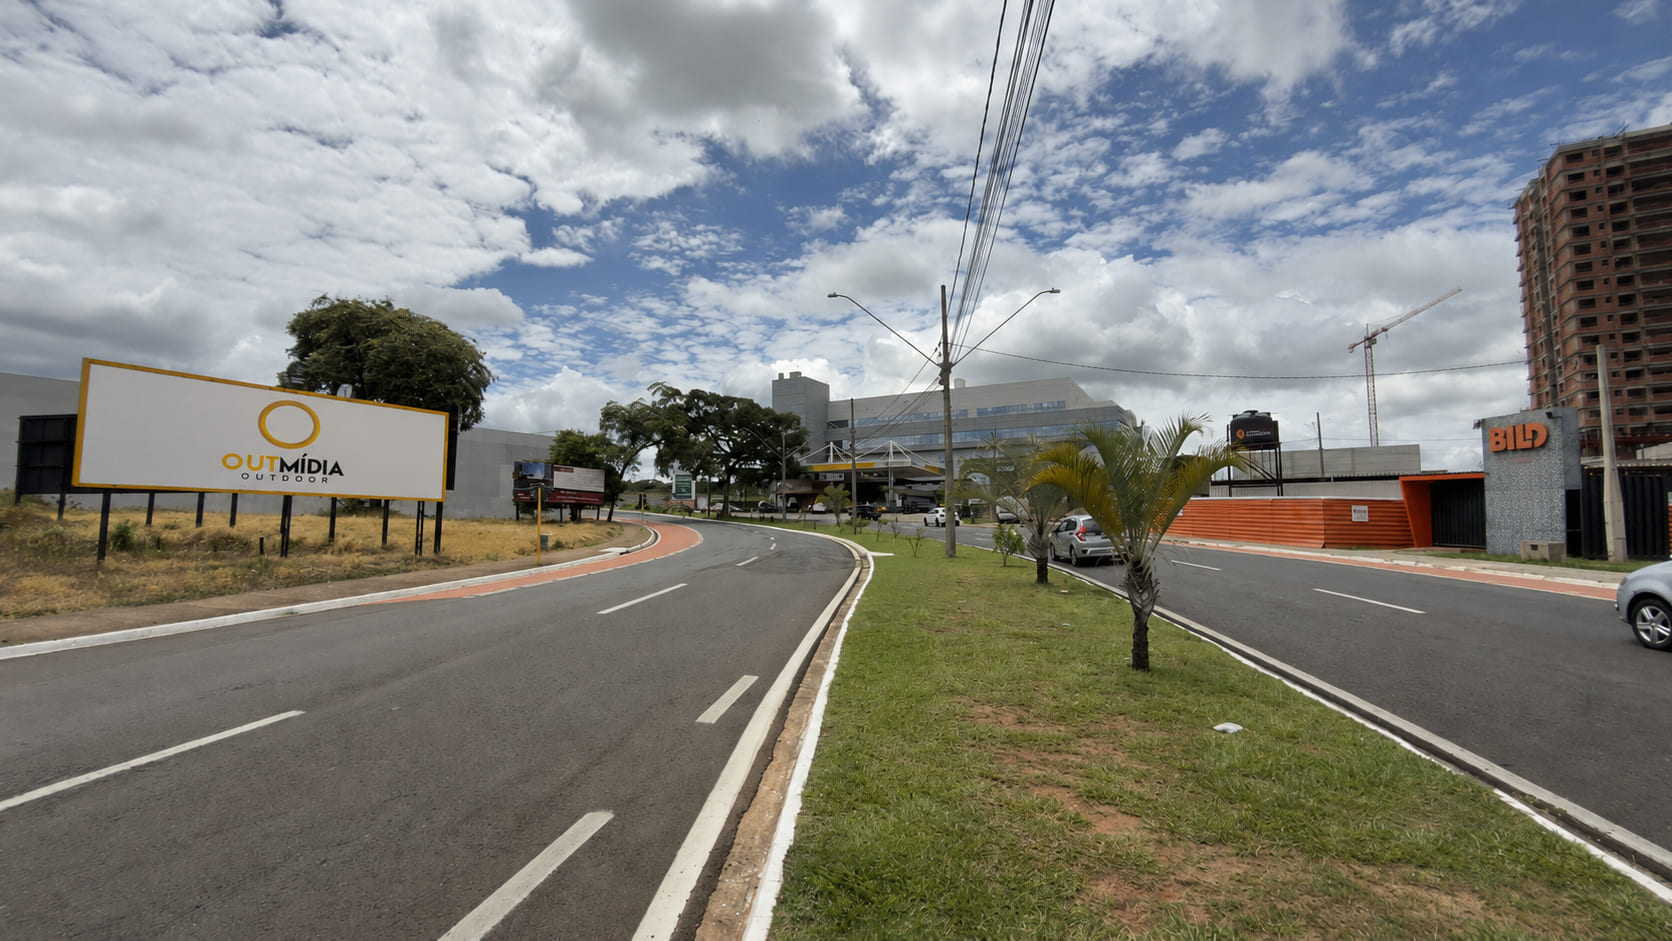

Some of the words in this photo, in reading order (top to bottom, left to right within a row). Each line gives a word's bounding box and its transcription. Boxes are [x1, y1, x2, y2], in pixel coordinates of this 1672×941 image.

[1489, 422, 1548, 452] BILD
[222, 453, 344, 476] OUTMÍDIA
[241, 472, 328, 484] OUTDOOR
